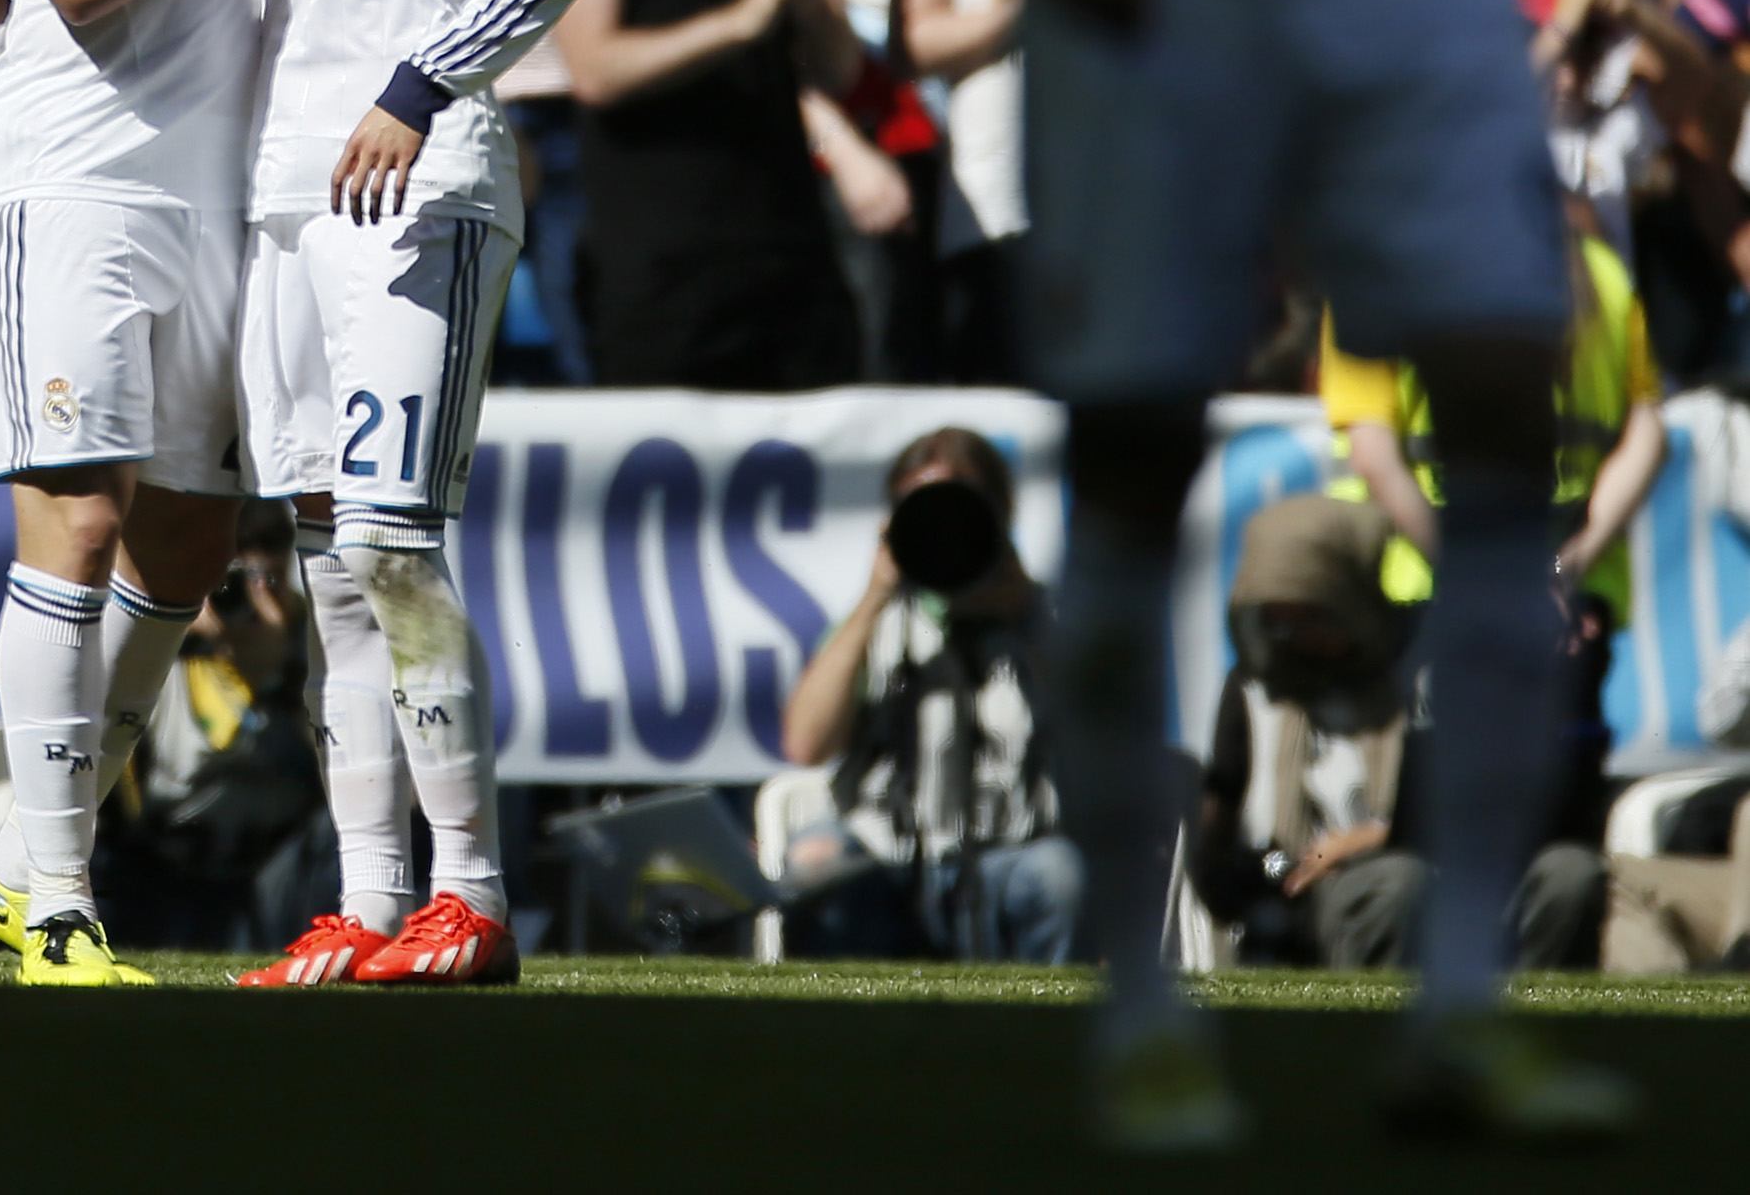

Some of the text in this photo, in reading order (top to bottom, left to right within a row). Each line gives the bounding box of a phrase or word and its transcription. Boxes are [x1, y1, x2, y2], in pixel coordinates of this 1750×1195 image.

[341, 389, 423, 482] 21
[393, 689, 452, 727] RM
[44, 743, 93, 775] RM
